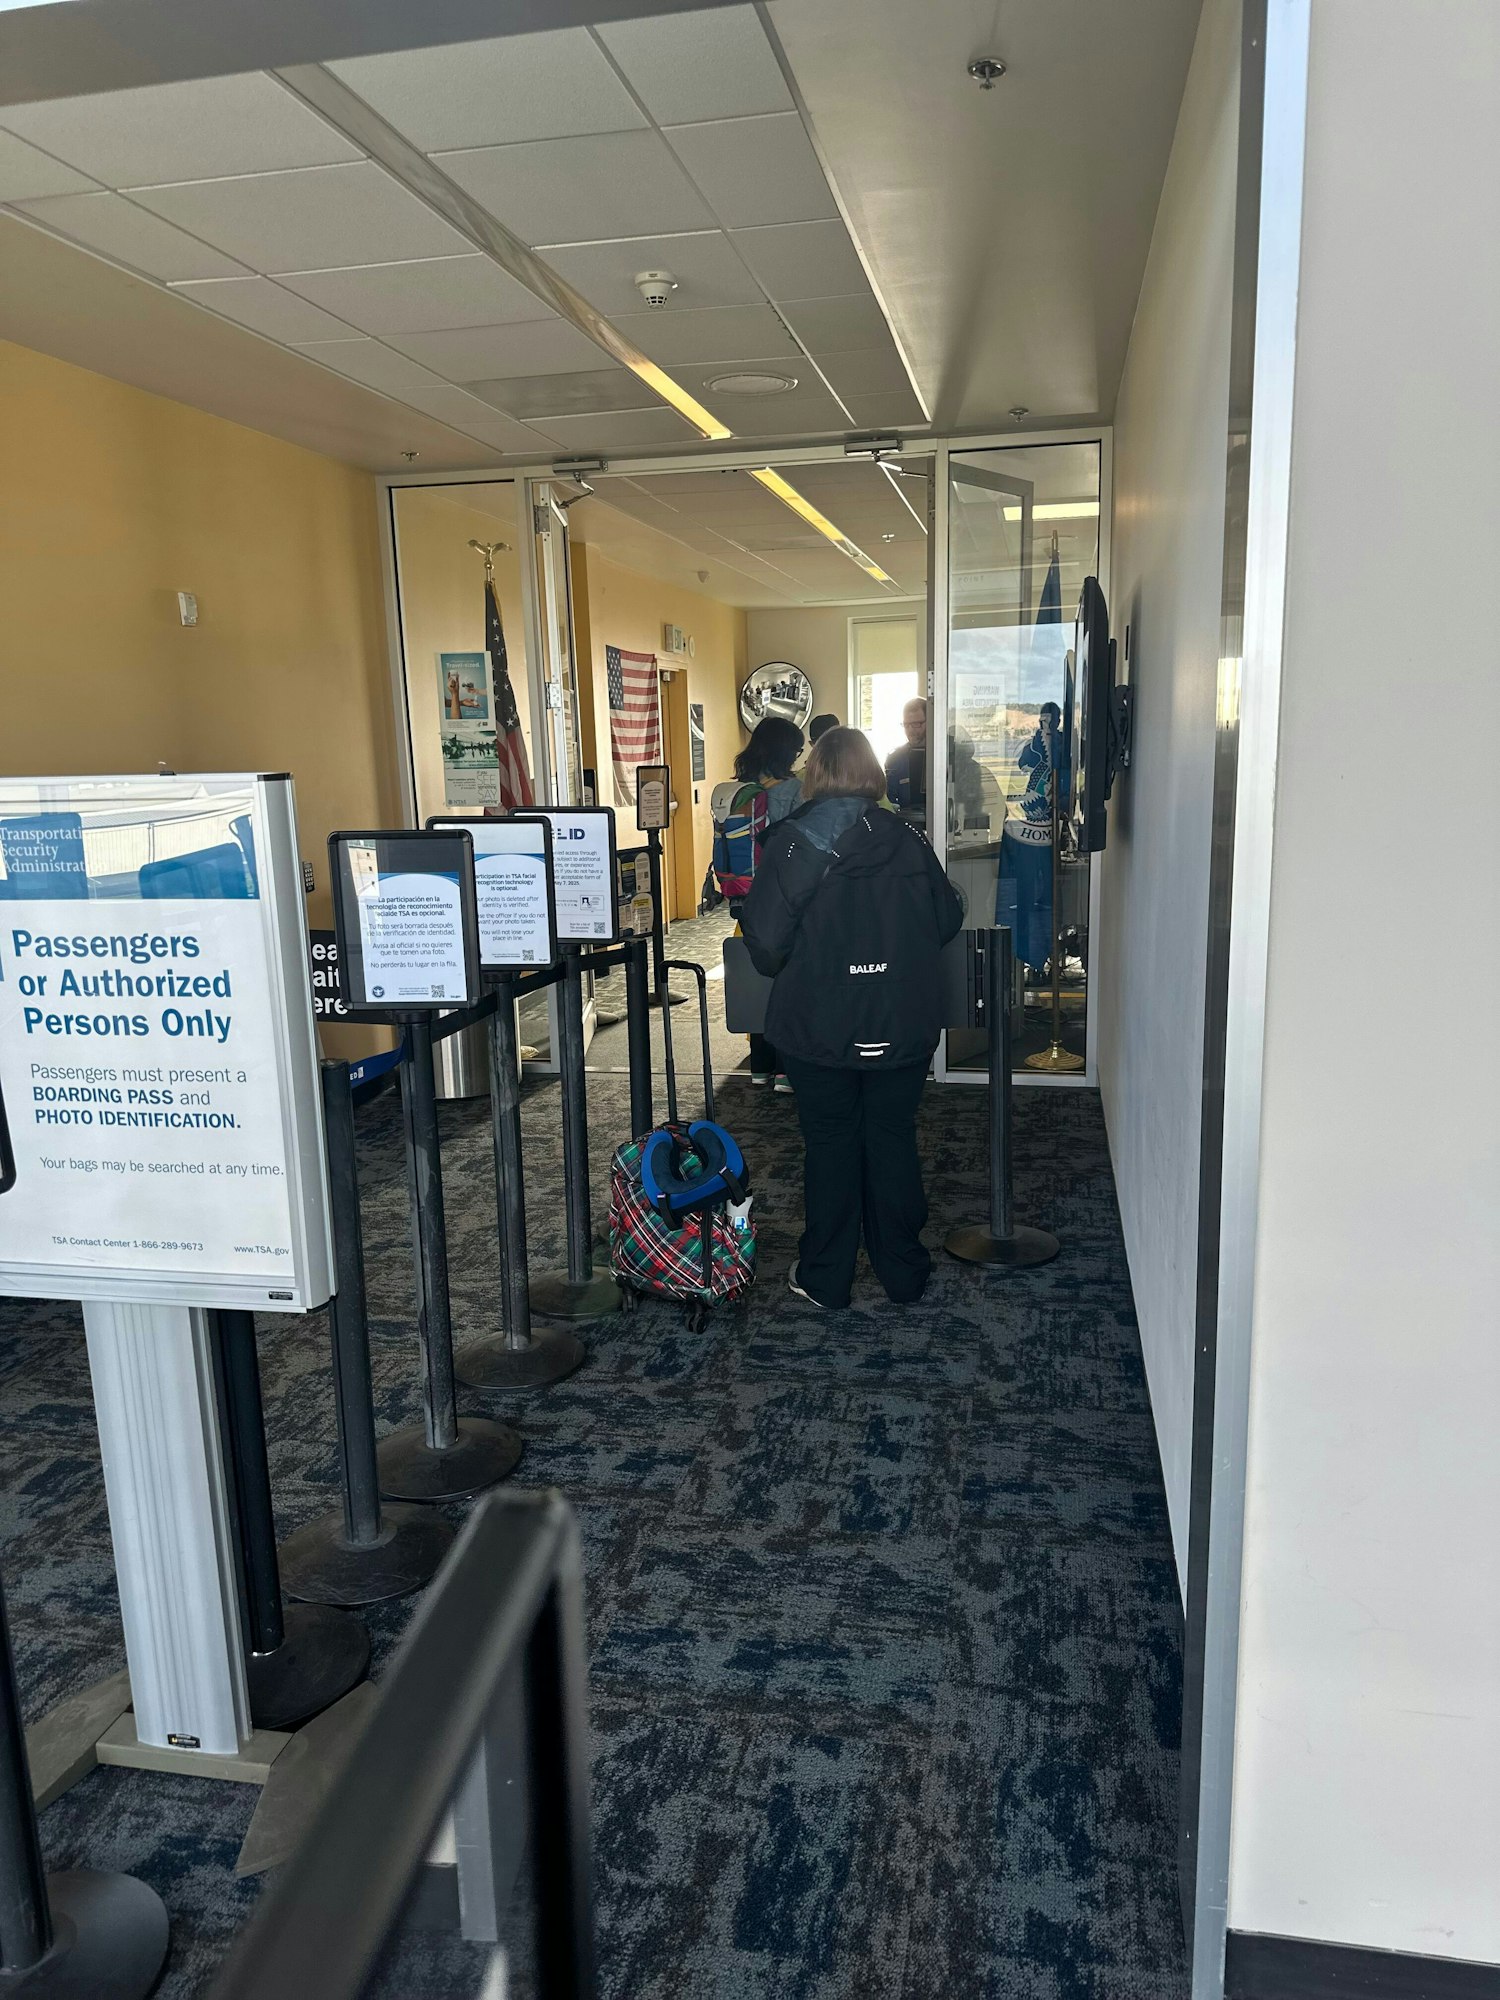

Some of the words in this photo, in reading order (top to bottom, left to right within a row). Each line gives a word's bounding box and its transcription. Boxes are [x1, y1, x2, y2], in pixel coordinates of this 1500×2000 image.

[12, 930, 200, 964] Passengers
[313, 966, 340, 987] ait
[850, 963, 887, 974] BALEAF
[19, 974, 47, 996] or
[60, 968, 232, 998] Authorized
[315, 997, 348, 1014] ere
[24, 1007, 150, 1036] Persons
[162, 1008, 232, 1043] Only
[30, 1063, 117, 1084] Passengers
[122, 1067, 163, 1082] must
[169, 1068, 231, 1085] present
[236, 1071, 247, 1083] a
[32, 1086, 122, 1104] BOARDING
[128, 1090, 174, 1105] PASS
[180, 1090, 211, 1105] and
[35, 1109, 93, 1125] PHOTO
[99, 1110, 241, 1128] IDENTIFICATION.
[40, 1157, 66, 1170] Your
[69, 1158, 98, 1172] bags
[102, 1160, 126, 1174] may
[129, 1159, 145, 1172] be
[148, 1160, 205, 1174] searched
[209, 1162, 222, 1174] at
[226, 1164, 248, 1178] any
[252, 1163, 285, 1176] time.
[52, 1236, 68, 1245] TSA
[69, 1237, 101, 1247] Contact
[103, 1238, 131, 1248] Center
[133, 1240, 204, 1251] 1-866-289-9673
[234, 1244, 290, 1256] www.TSA.gov
